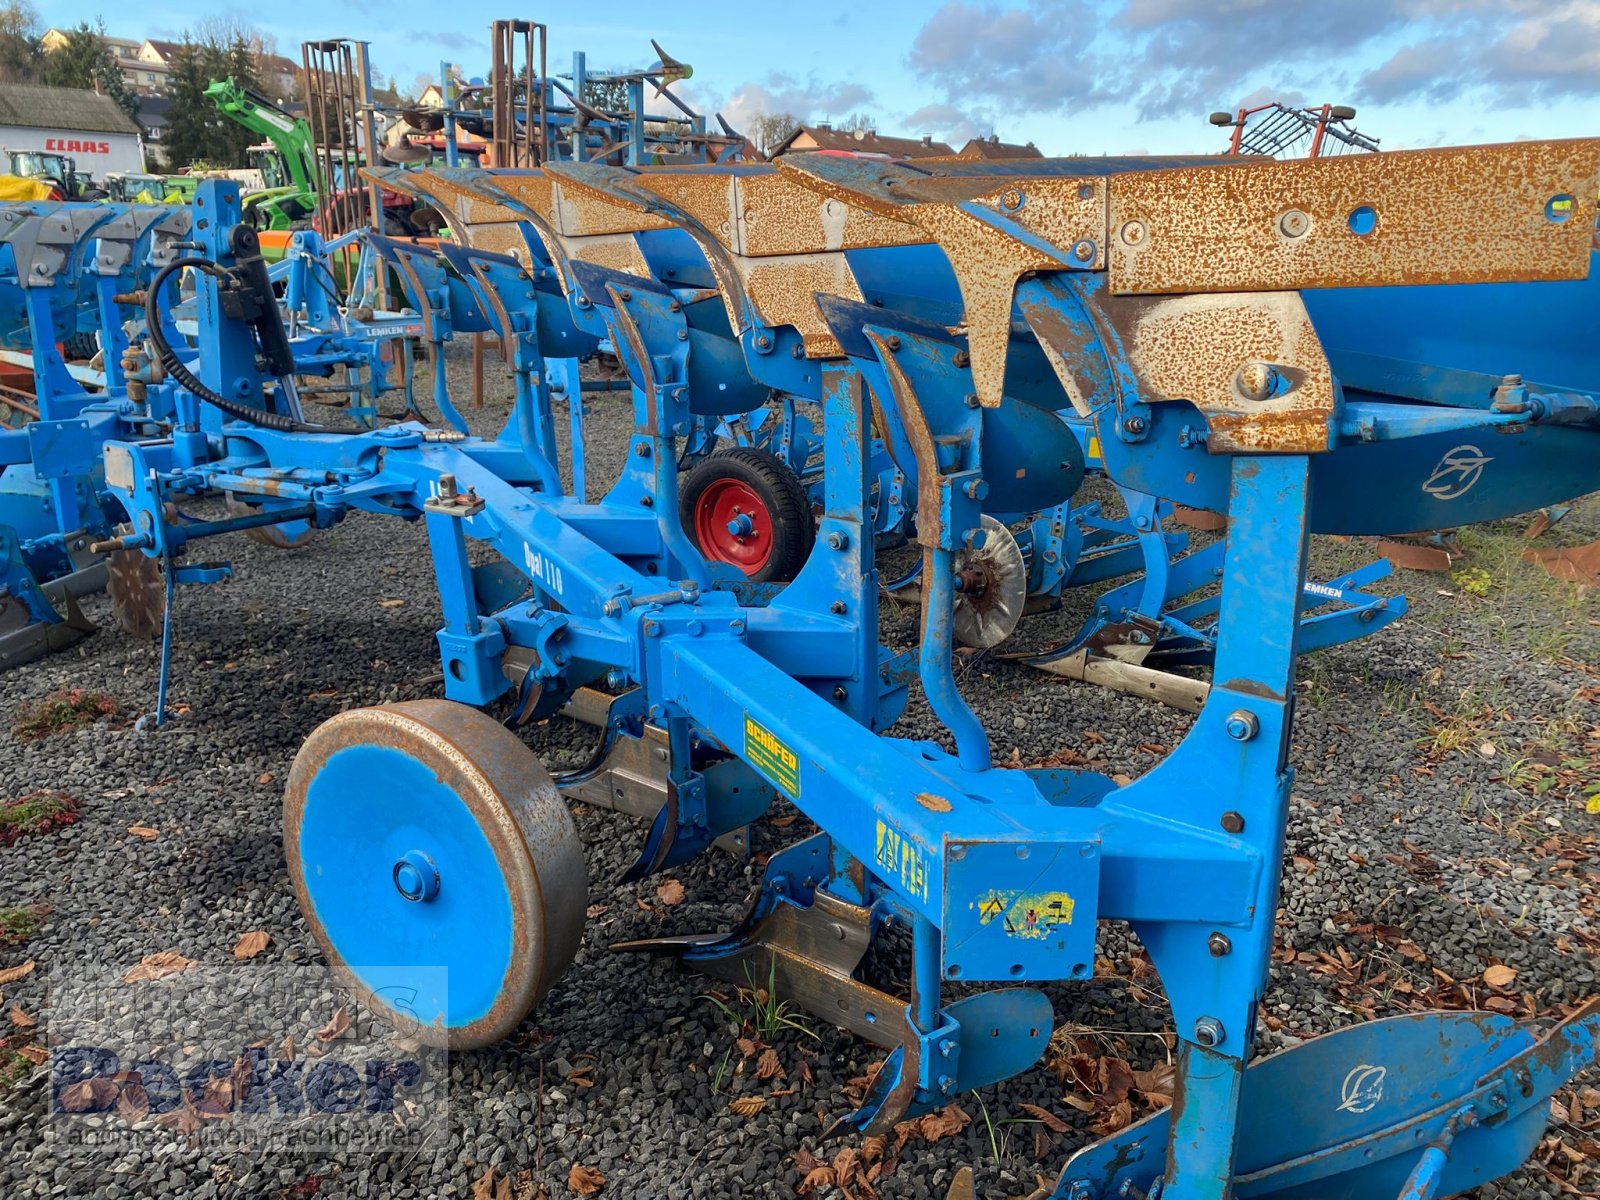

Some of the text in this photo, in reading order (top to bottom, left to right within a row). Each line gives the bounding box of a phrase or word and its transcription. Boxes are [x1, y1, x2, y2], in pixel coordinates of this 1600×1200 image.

[45, 139, 109, 154] CLAAS
[366, 326, 403, 337] LEMKEN
[523, 541, 563, 596] Opal 110
[1304, 582, 1343, 598] EMKEN
[746, 719, 797, 772] SCHÄFER
